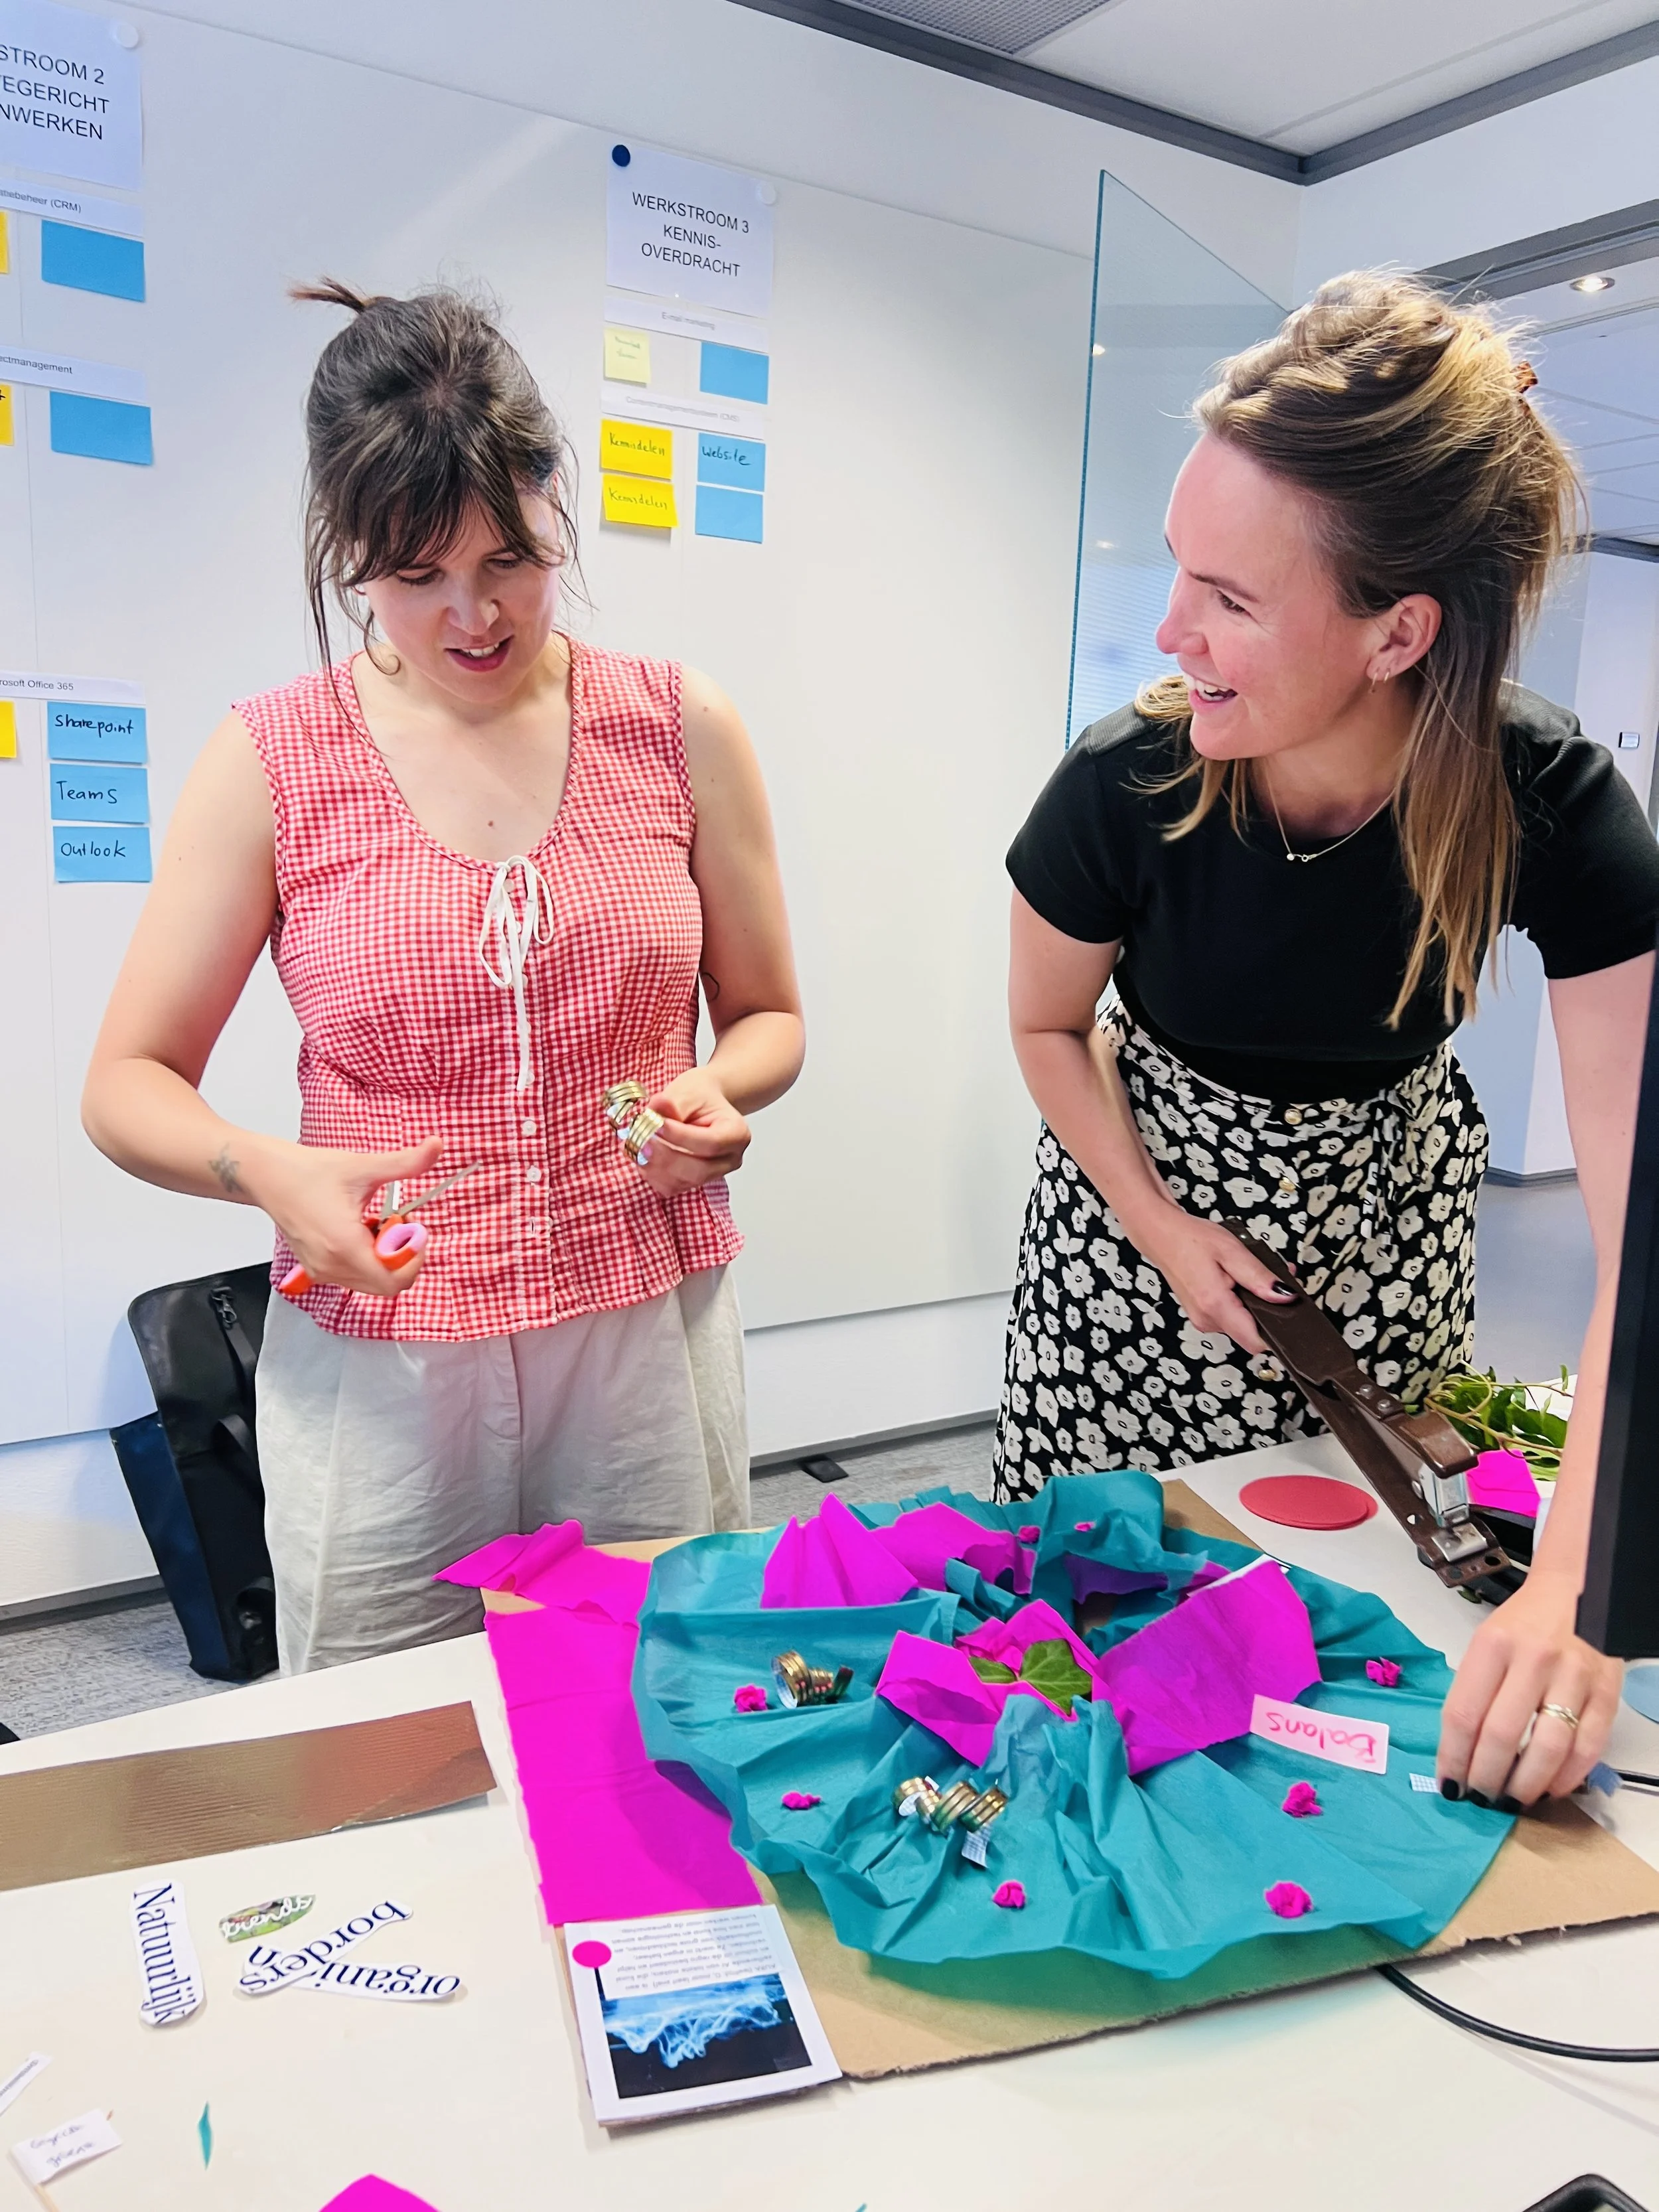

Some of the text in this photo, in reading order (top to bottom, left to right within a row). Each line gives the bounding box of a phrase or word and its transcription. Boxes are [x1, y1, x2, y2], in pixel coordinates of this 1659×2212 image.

[94, 68, 104, 85] 2
[0, 74, 109, 113] EGERICHT
[50, 198, 82, 214] (CRM)
[632, 191, 750, 234] WERKSTROOM 3
[664, 224, 721, 250] KENNIS-
[641, 242, 741, 277] OVERDRACHT
[702, 446, 752, 466] Website
[28, 680, 54, 690] Office
[57, 682, 74, 691] 365
[60, 840, 126, 857] Outlook
[133, 1883, 198, 2024] Natuurlijk
[240, 1901, 408, 1994] borders
